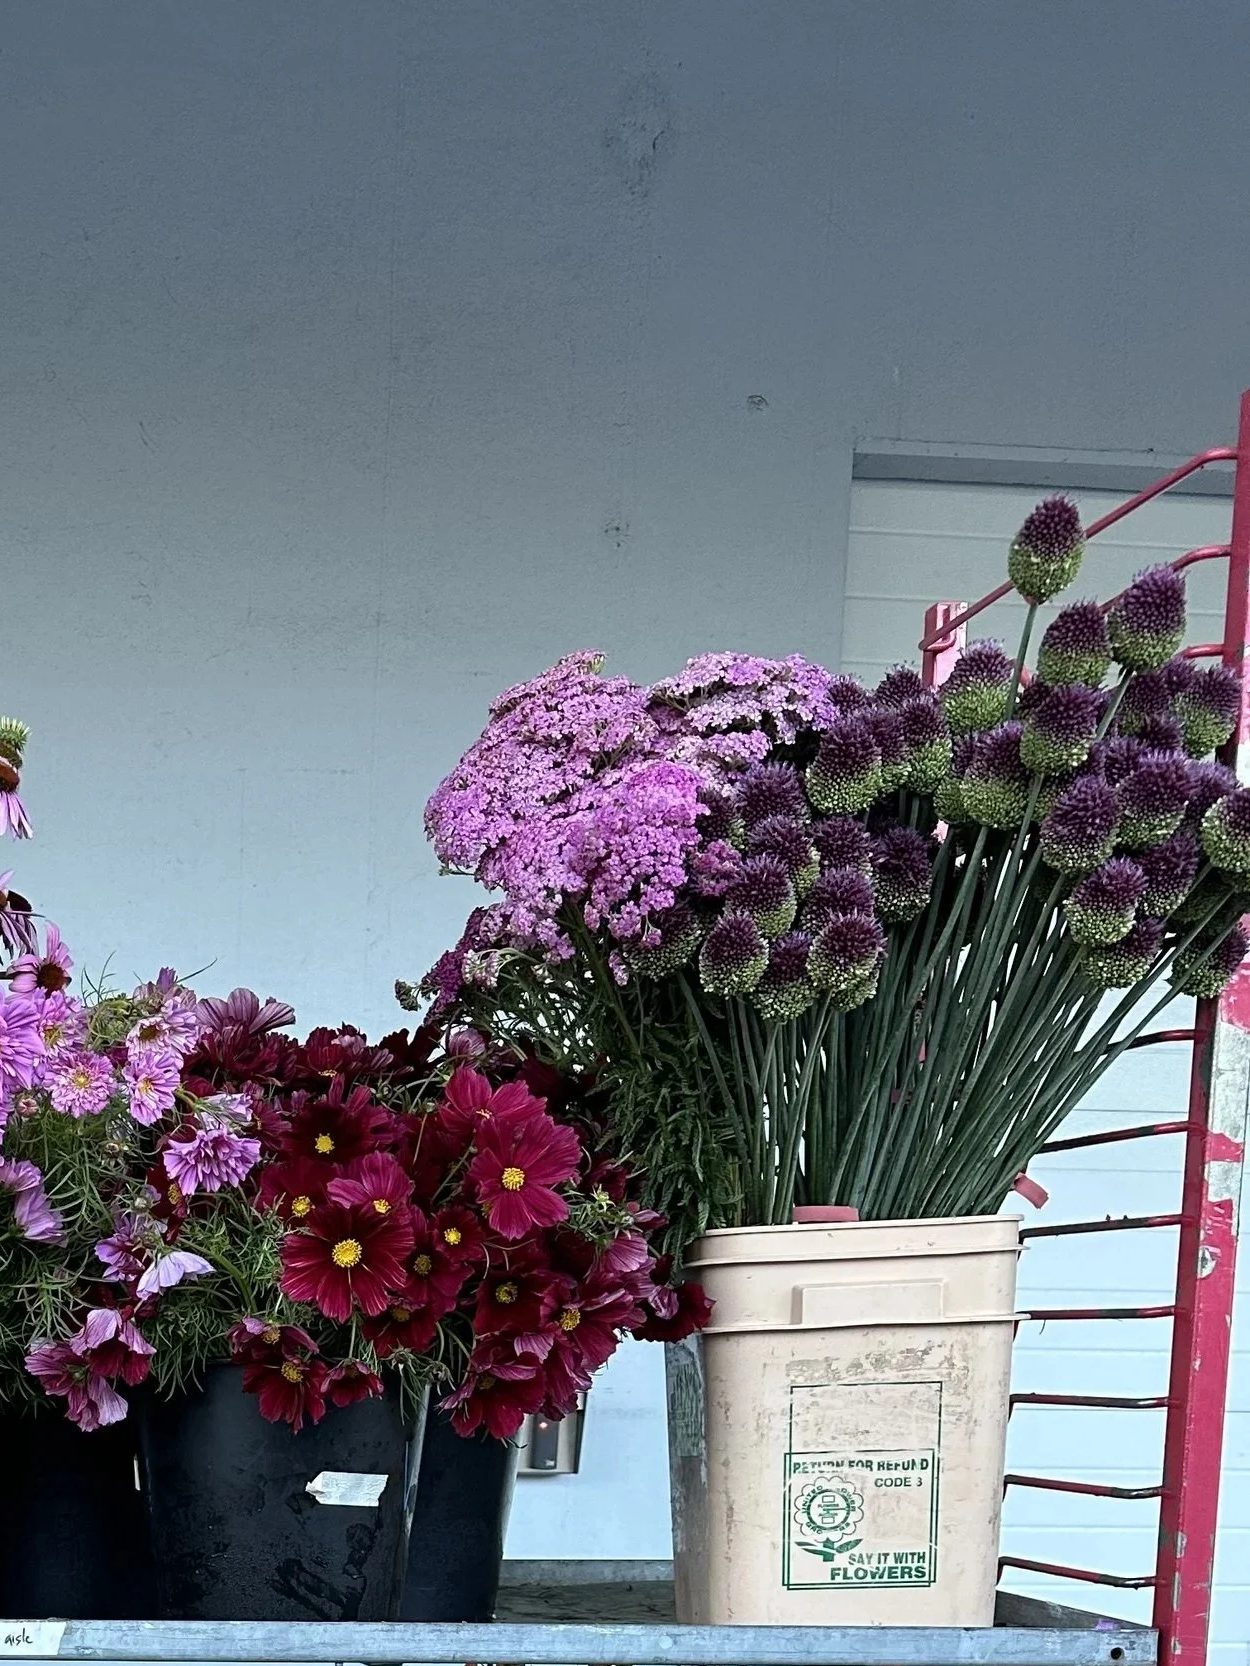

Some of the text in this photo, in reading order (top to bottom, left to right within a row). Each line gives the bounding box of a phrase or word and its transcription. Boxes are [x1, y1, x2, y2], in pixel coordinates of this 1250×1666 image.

[874, 1477, 911, 1488] CODE
[848, 1551, 926, 1565] SAY IT WITH
[830, 1566, 927, 1581] FLOWERS
